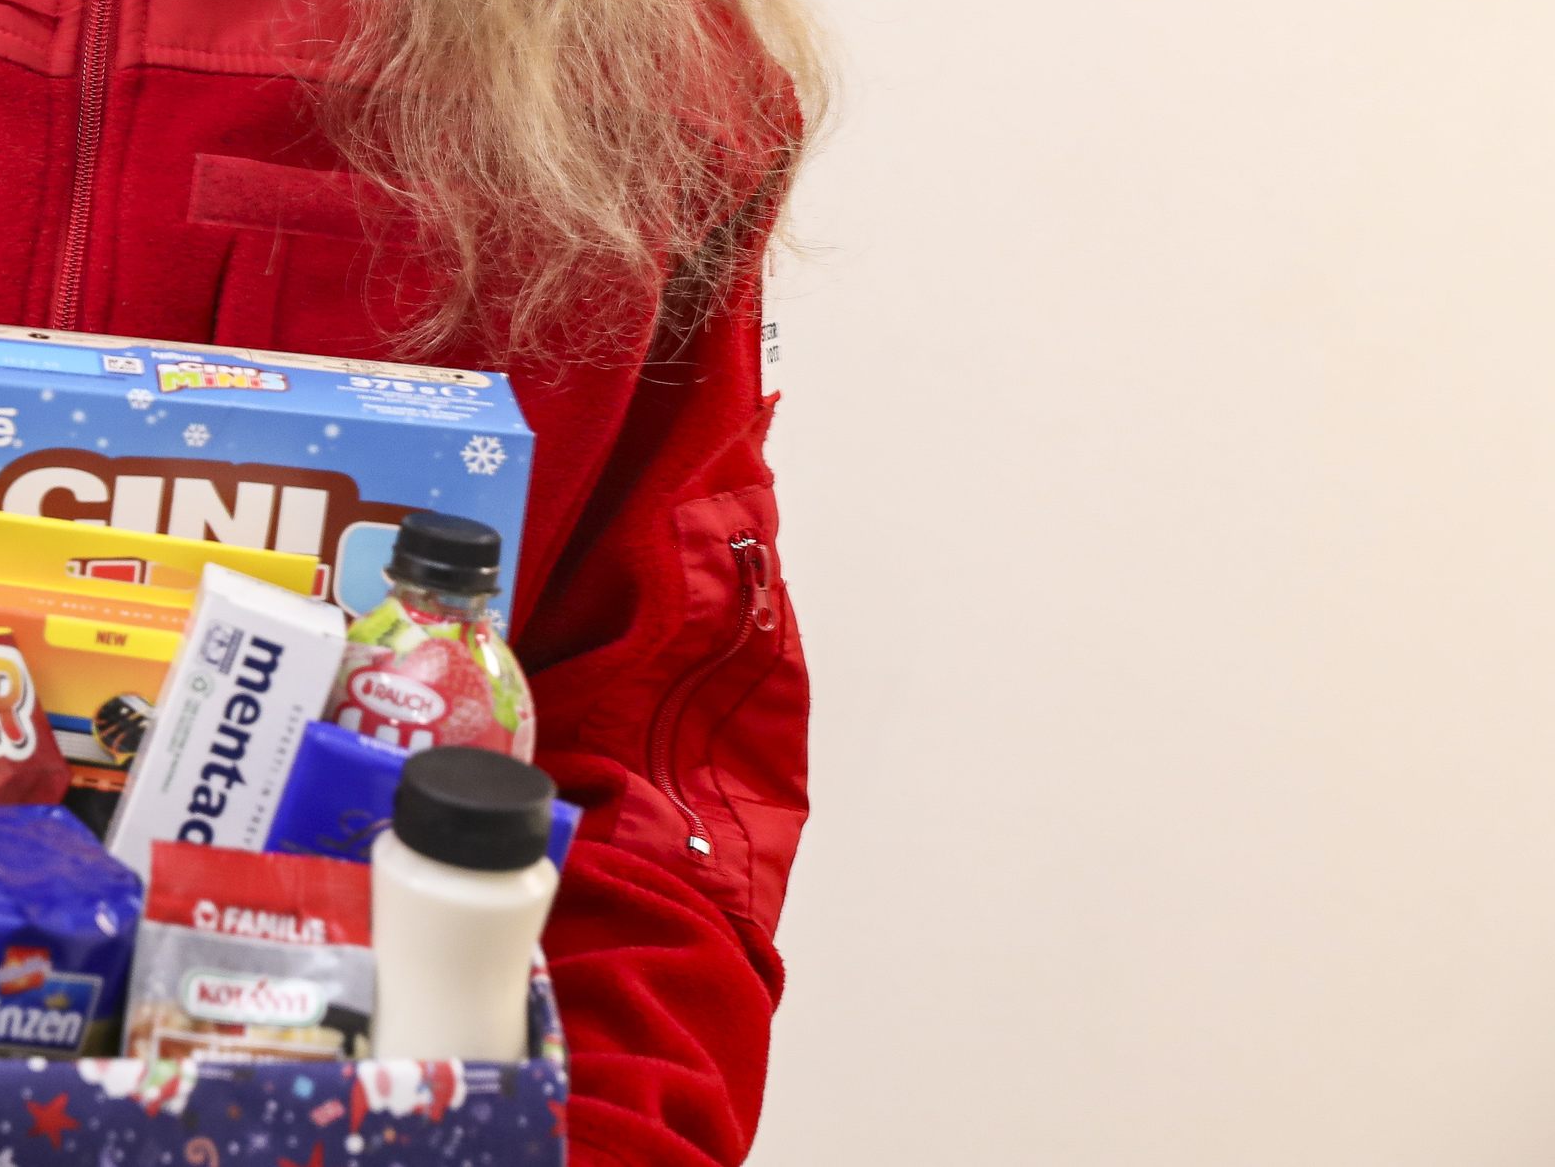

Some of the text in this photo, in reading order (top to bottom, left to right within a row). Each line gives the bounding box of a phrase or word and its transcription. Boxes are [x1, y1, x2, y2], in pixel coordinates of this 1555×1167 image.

[1, 466, 329, 555] CINI
[95, 630, 128, 647] NEW
[374, 683, 434, 711] RAUCH
